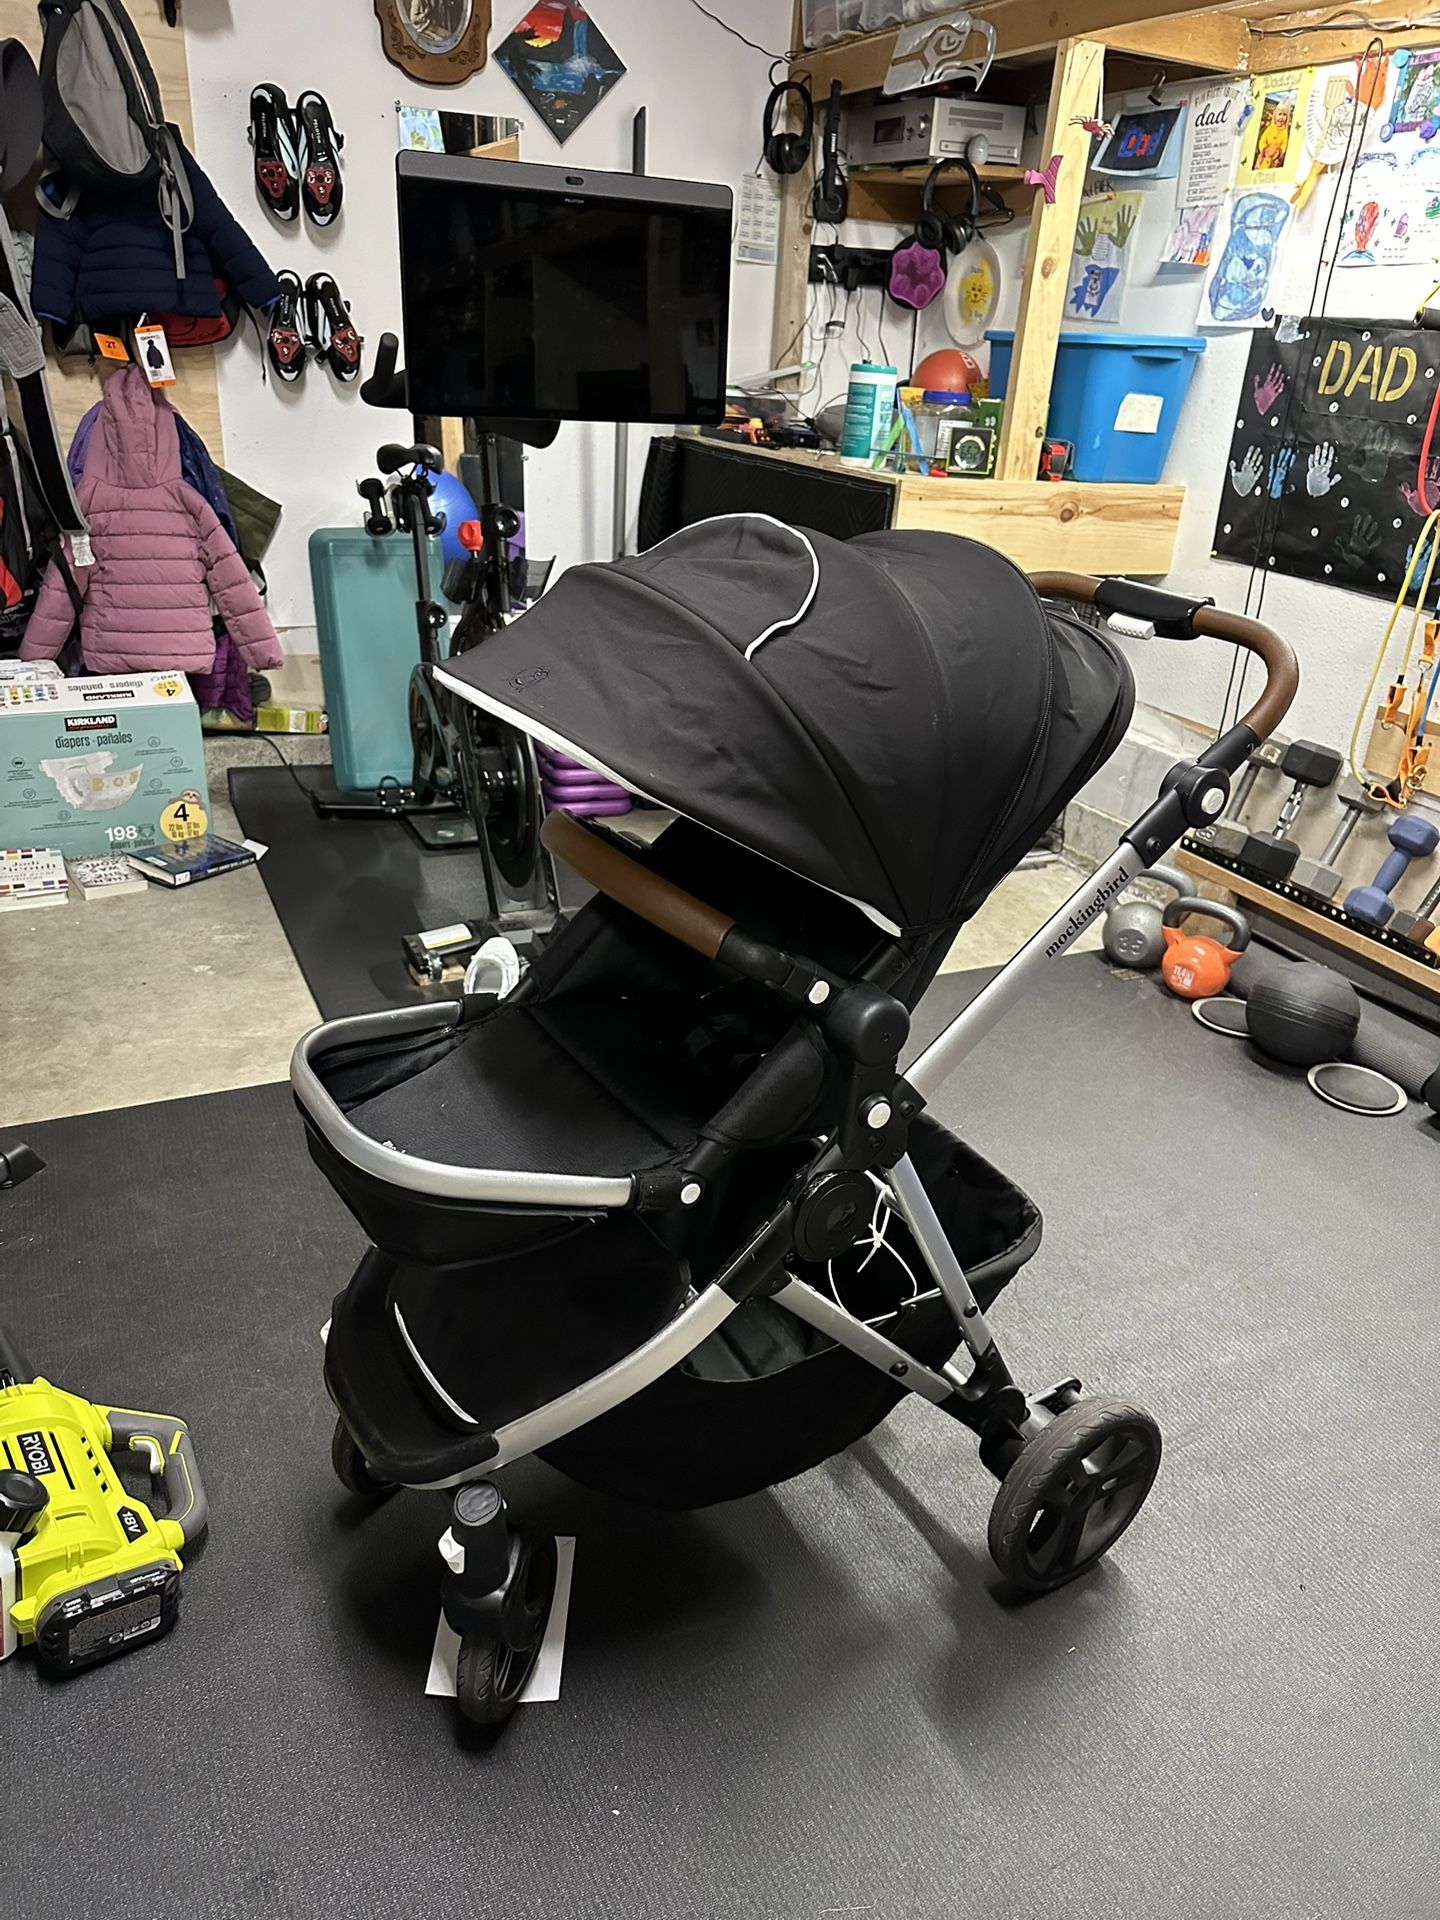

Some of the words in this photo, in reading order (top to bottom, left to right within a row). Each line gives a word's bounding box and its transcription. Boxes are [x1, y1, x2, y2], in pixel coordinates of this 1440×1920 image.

[1194, 99, 1231, 128] dad
[1317, 340, 1417, 402] DAD
[66, 715, 116, 728] KIRKLAND
[55, 736, 91, 750] diapers
[96, 731, 133, 746] pañales
[173, 803, 189, 822] 4
[104, 825, 138, 841] 198
[1045, 865, 1129, 959] mockingbird
[22, 1434, 51, 1475] RYOBI
[122, 1511, 141, 1533] 18V
